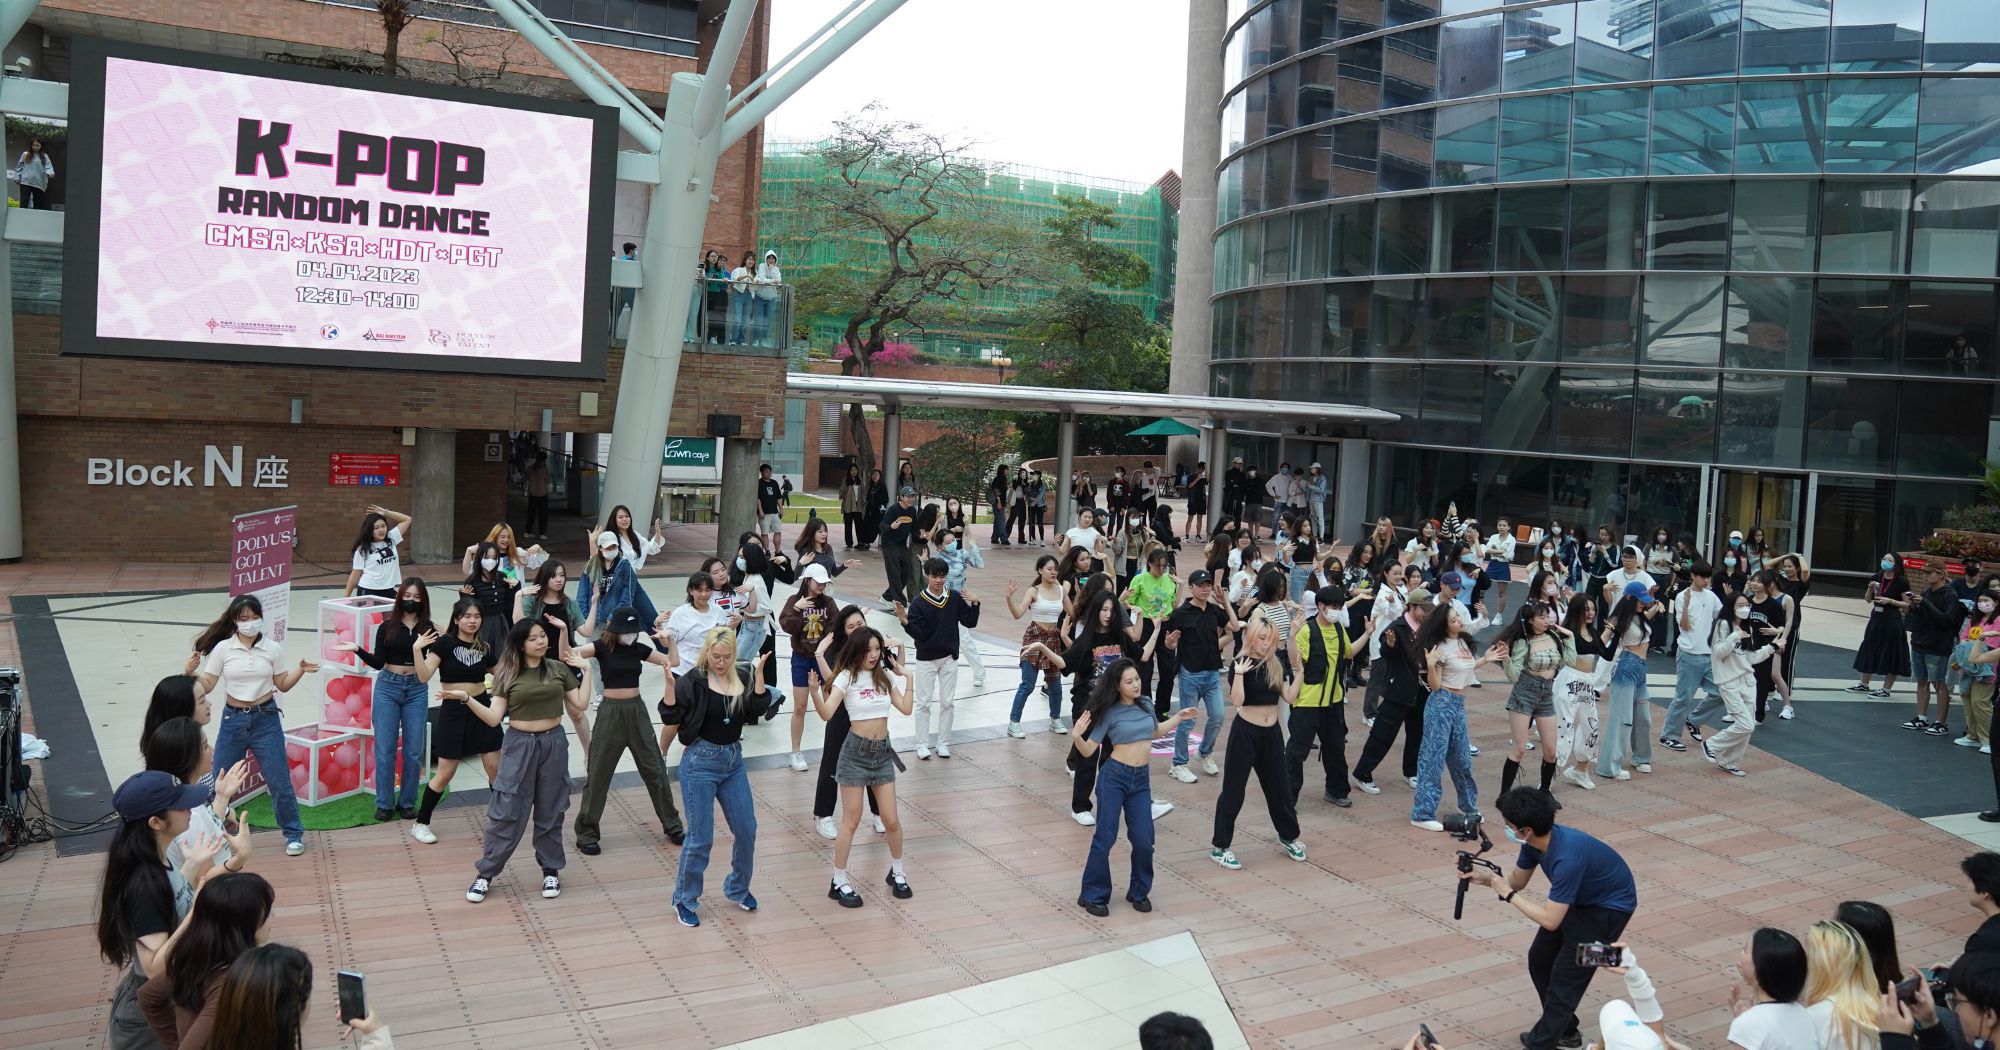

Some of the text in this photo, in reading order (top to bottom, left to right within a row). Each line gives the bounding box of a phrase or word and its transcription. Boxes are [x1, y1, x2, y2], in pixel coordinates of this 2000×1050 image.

[235, 117, 485, 196] K-POP
[218, 186, 490, 237] RANDOM DANCE
[296, 260, 420, 285] 04.04.2023
[295, 286, 420, 310] 12:30-14:00
[664, 443, 691, 458] Lawn
[87, 444, 289, 488] Block N 座
[235, 551, 266, 570] GOT
[235, 562, 286, 587] TALENT
